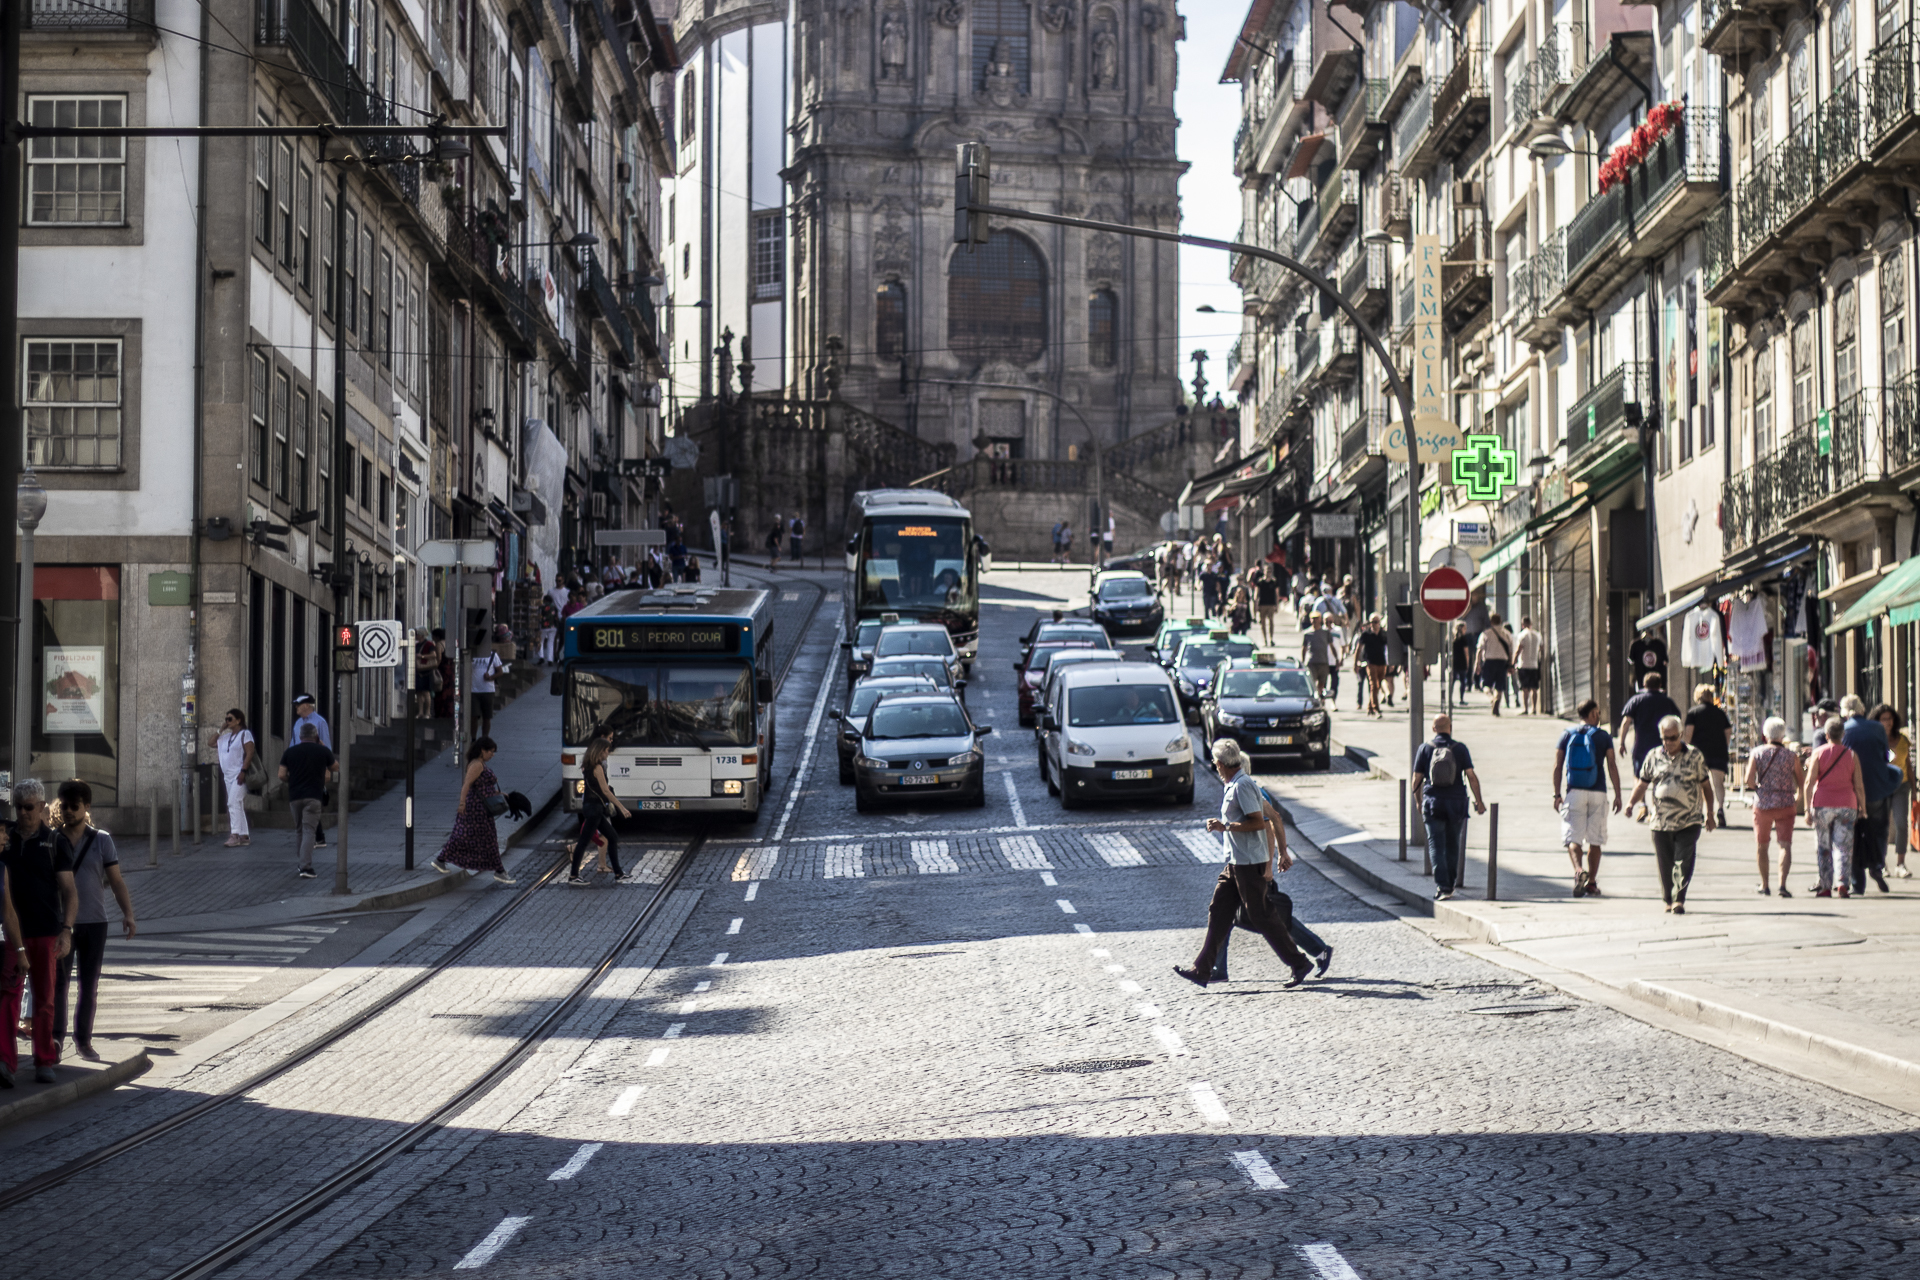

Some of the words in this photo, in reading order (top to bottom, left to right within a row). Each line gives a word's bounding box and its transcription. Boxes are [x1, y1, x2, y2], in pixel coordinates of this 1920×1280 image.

[1419, 246, 1438, 397] FARMÁCIA
[1420, 405, 1439, 414] DOS
[1388, 429, 1459, 455] Clrigos
[595, 629, 626, 648] 801
[648, 632, 685, 643] PEDRO
[691, 632, 722, 643] COVA
[715, 756, 738, 764] 1738
